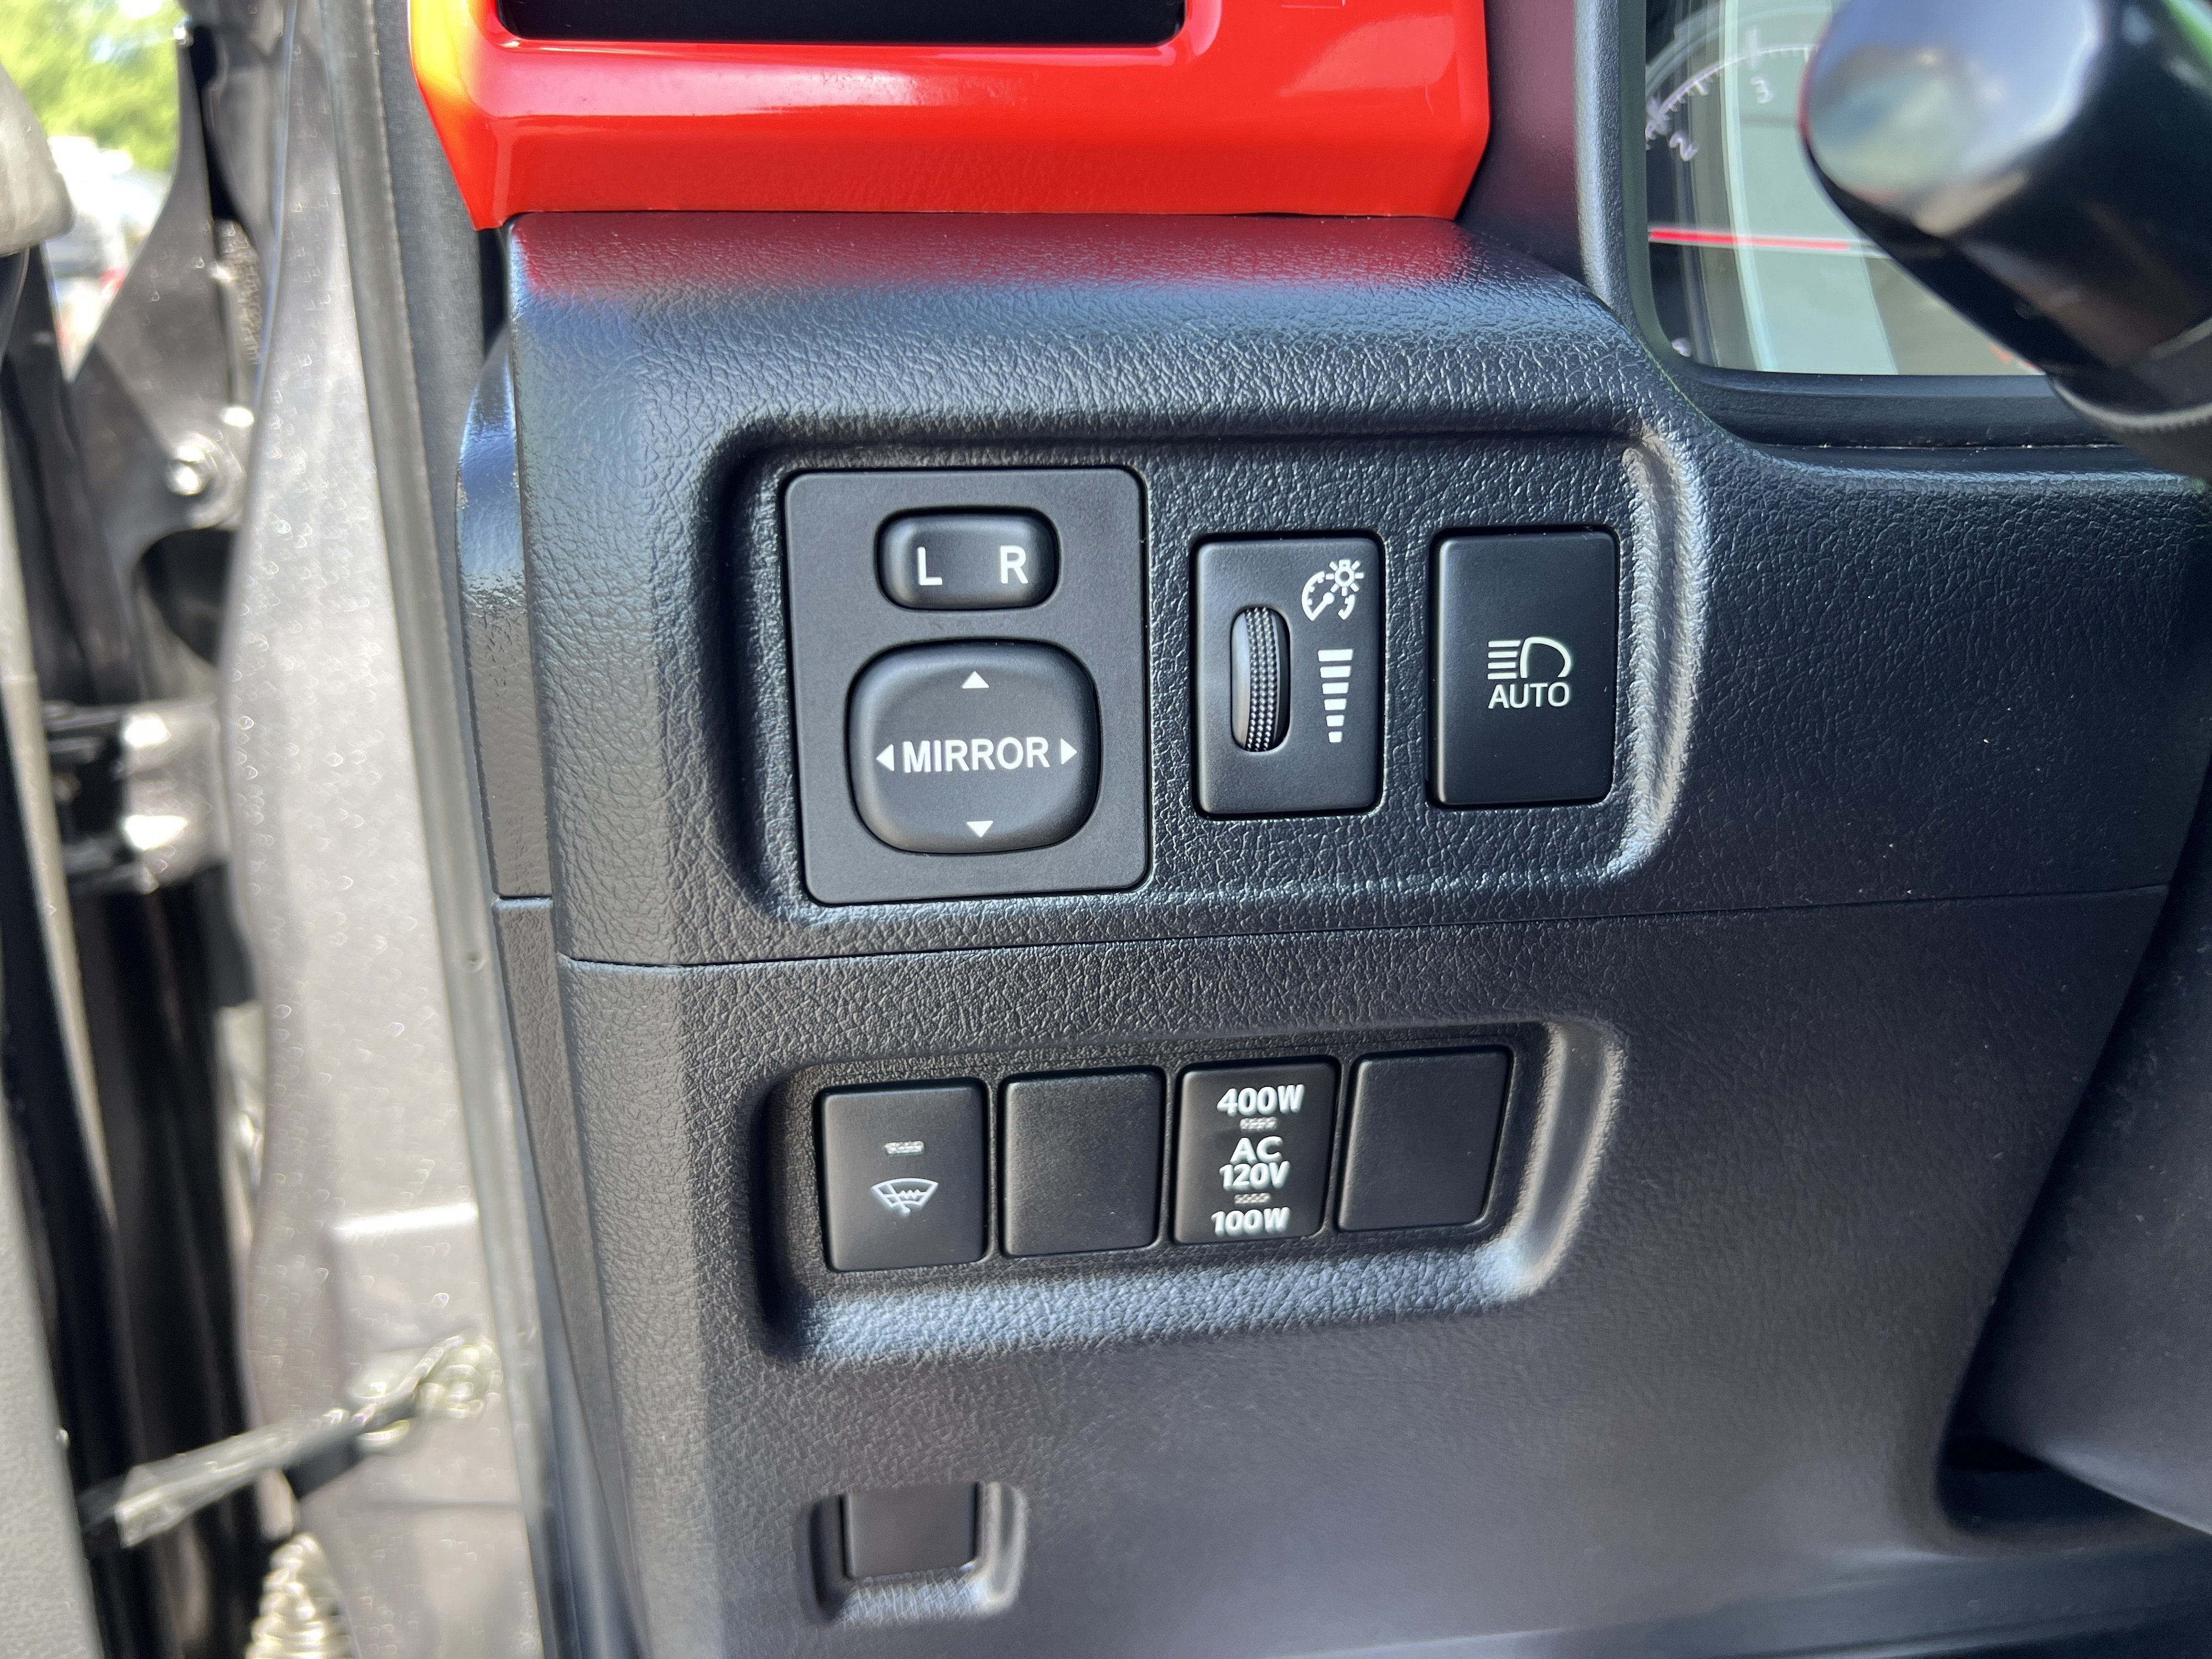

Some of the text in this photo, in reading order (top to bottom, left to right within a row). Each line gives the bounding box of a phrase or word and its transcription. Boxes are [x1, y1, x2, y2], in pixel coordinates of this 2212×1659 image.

[1751, 76, 1773, 104] 3
[1669, 133, 1699, 161] 2
[917, 545, 1029, 586] L R
[1488, 682, 1571, 709] AUTO
[902, 736, 1051, 773] MIRROR
[1217, 1084, 1305, 1116] 400W
[1229, 1136, 1283, 1165] AC
[1218, 1160, 1290, 1191] 120V
[1211, 1206, 1290, 1237] 100W
